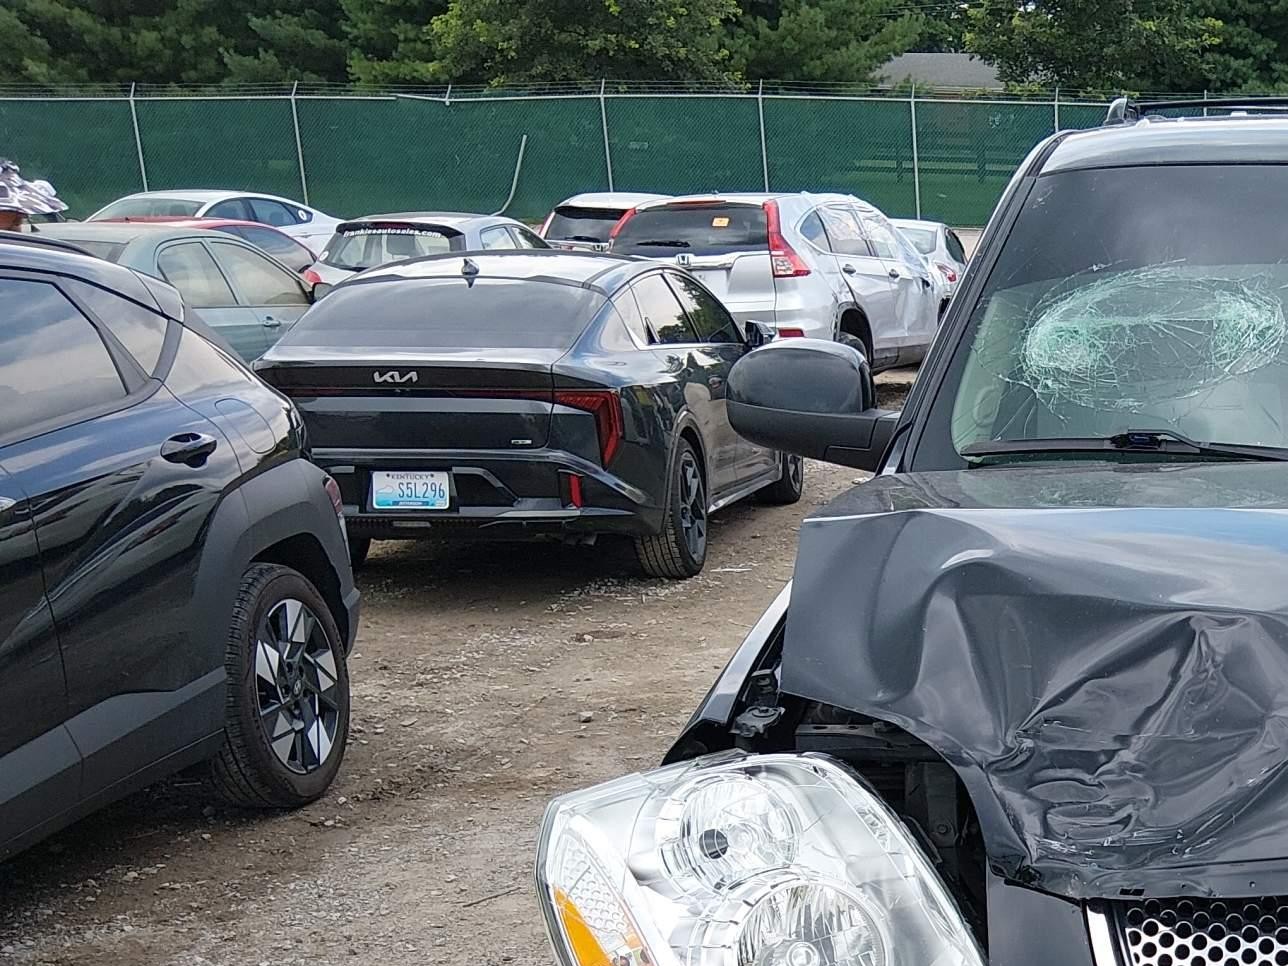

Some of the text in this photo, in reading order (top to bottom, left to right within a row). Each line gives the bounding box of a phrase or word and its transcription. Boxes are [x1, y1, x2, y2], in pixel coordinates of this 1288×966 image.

[343, 227, 442, 238] frankiesautosales.com
[373, 371, 418, 383] KIA
[398, 481, 445, 499] S5L296
